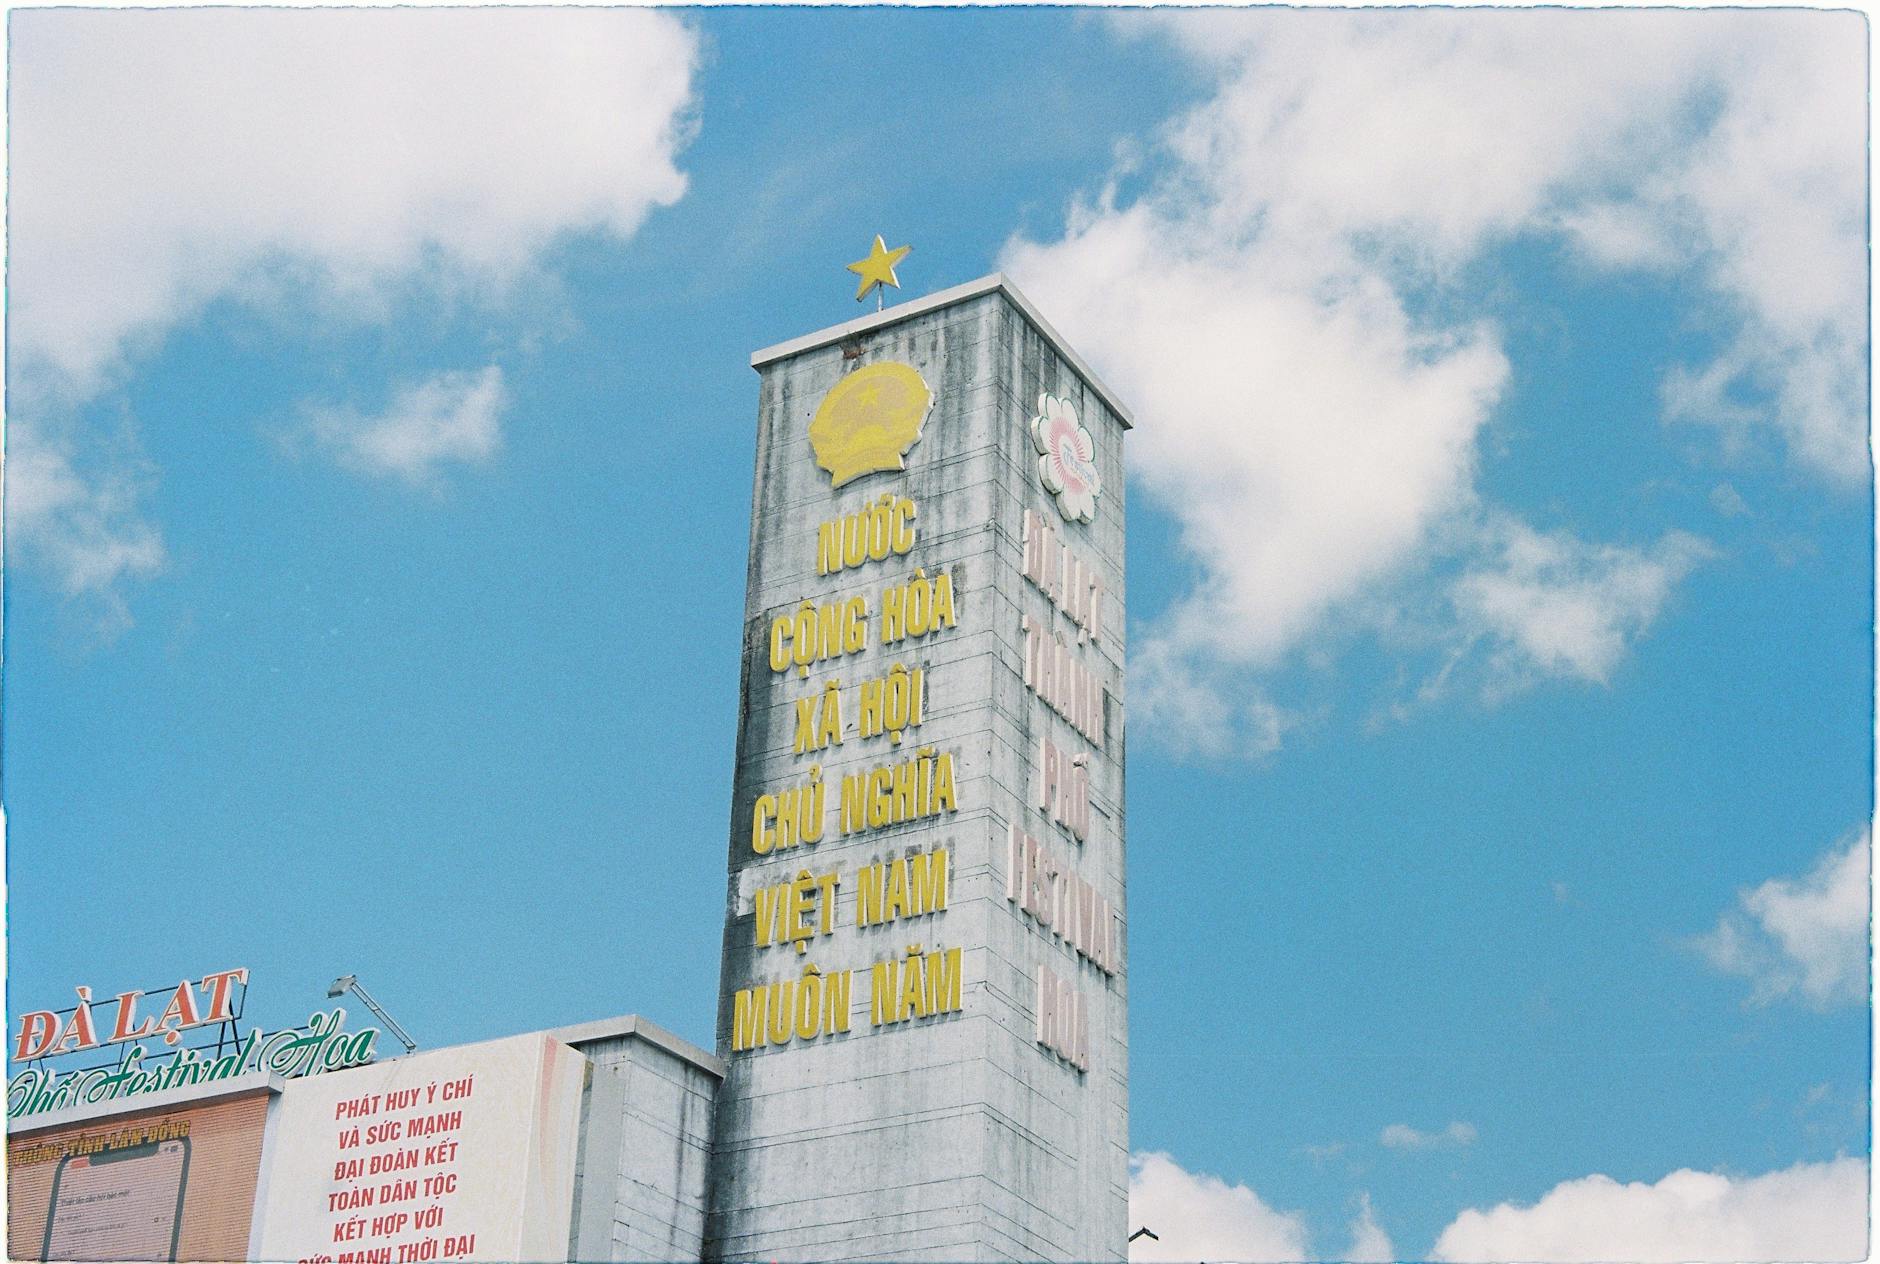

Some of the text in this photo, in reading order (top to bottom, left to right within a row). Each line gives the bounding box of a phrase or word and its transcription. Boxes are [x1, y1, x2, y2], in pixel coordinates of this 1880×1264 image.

[817, 492, 917, 577] NƯỚC
[770, 566, 957, 680] CỘNG HÒA
[793, 662, 924, 756] XÃ HỘI
[752, 745, 958, 855] CHỦ NGHĨA
[755, 848, 950, 955] VIỆT NAM
[12, 968, 250, 1062] ĐÀ LẠT
[732, 943, 963, 1051] MUÔN NĂM
[257, 1007, 380, 1080] Hoa
[335, 1073, 474, 1121] PHÁT HUY Ý CHÍ
[338, 1110, 462, 1150] VÀ SỨC MẠNH
[109, 1128, 145, 1150] LÂM
[147, 1118, 192, 1143] ĐỒNG
[334, 1137, 459, 1183] ĐẠI ĐOÀN KẾT
[328, 1171, 458, 1212] TOÀN DÂN TỘC
[333, 1204, 444, 1242] KẾT HỢP VỚI
[398, 1236, 438, 1264] THỜI
[443, 1233, 476, 1260] ĐẠI
